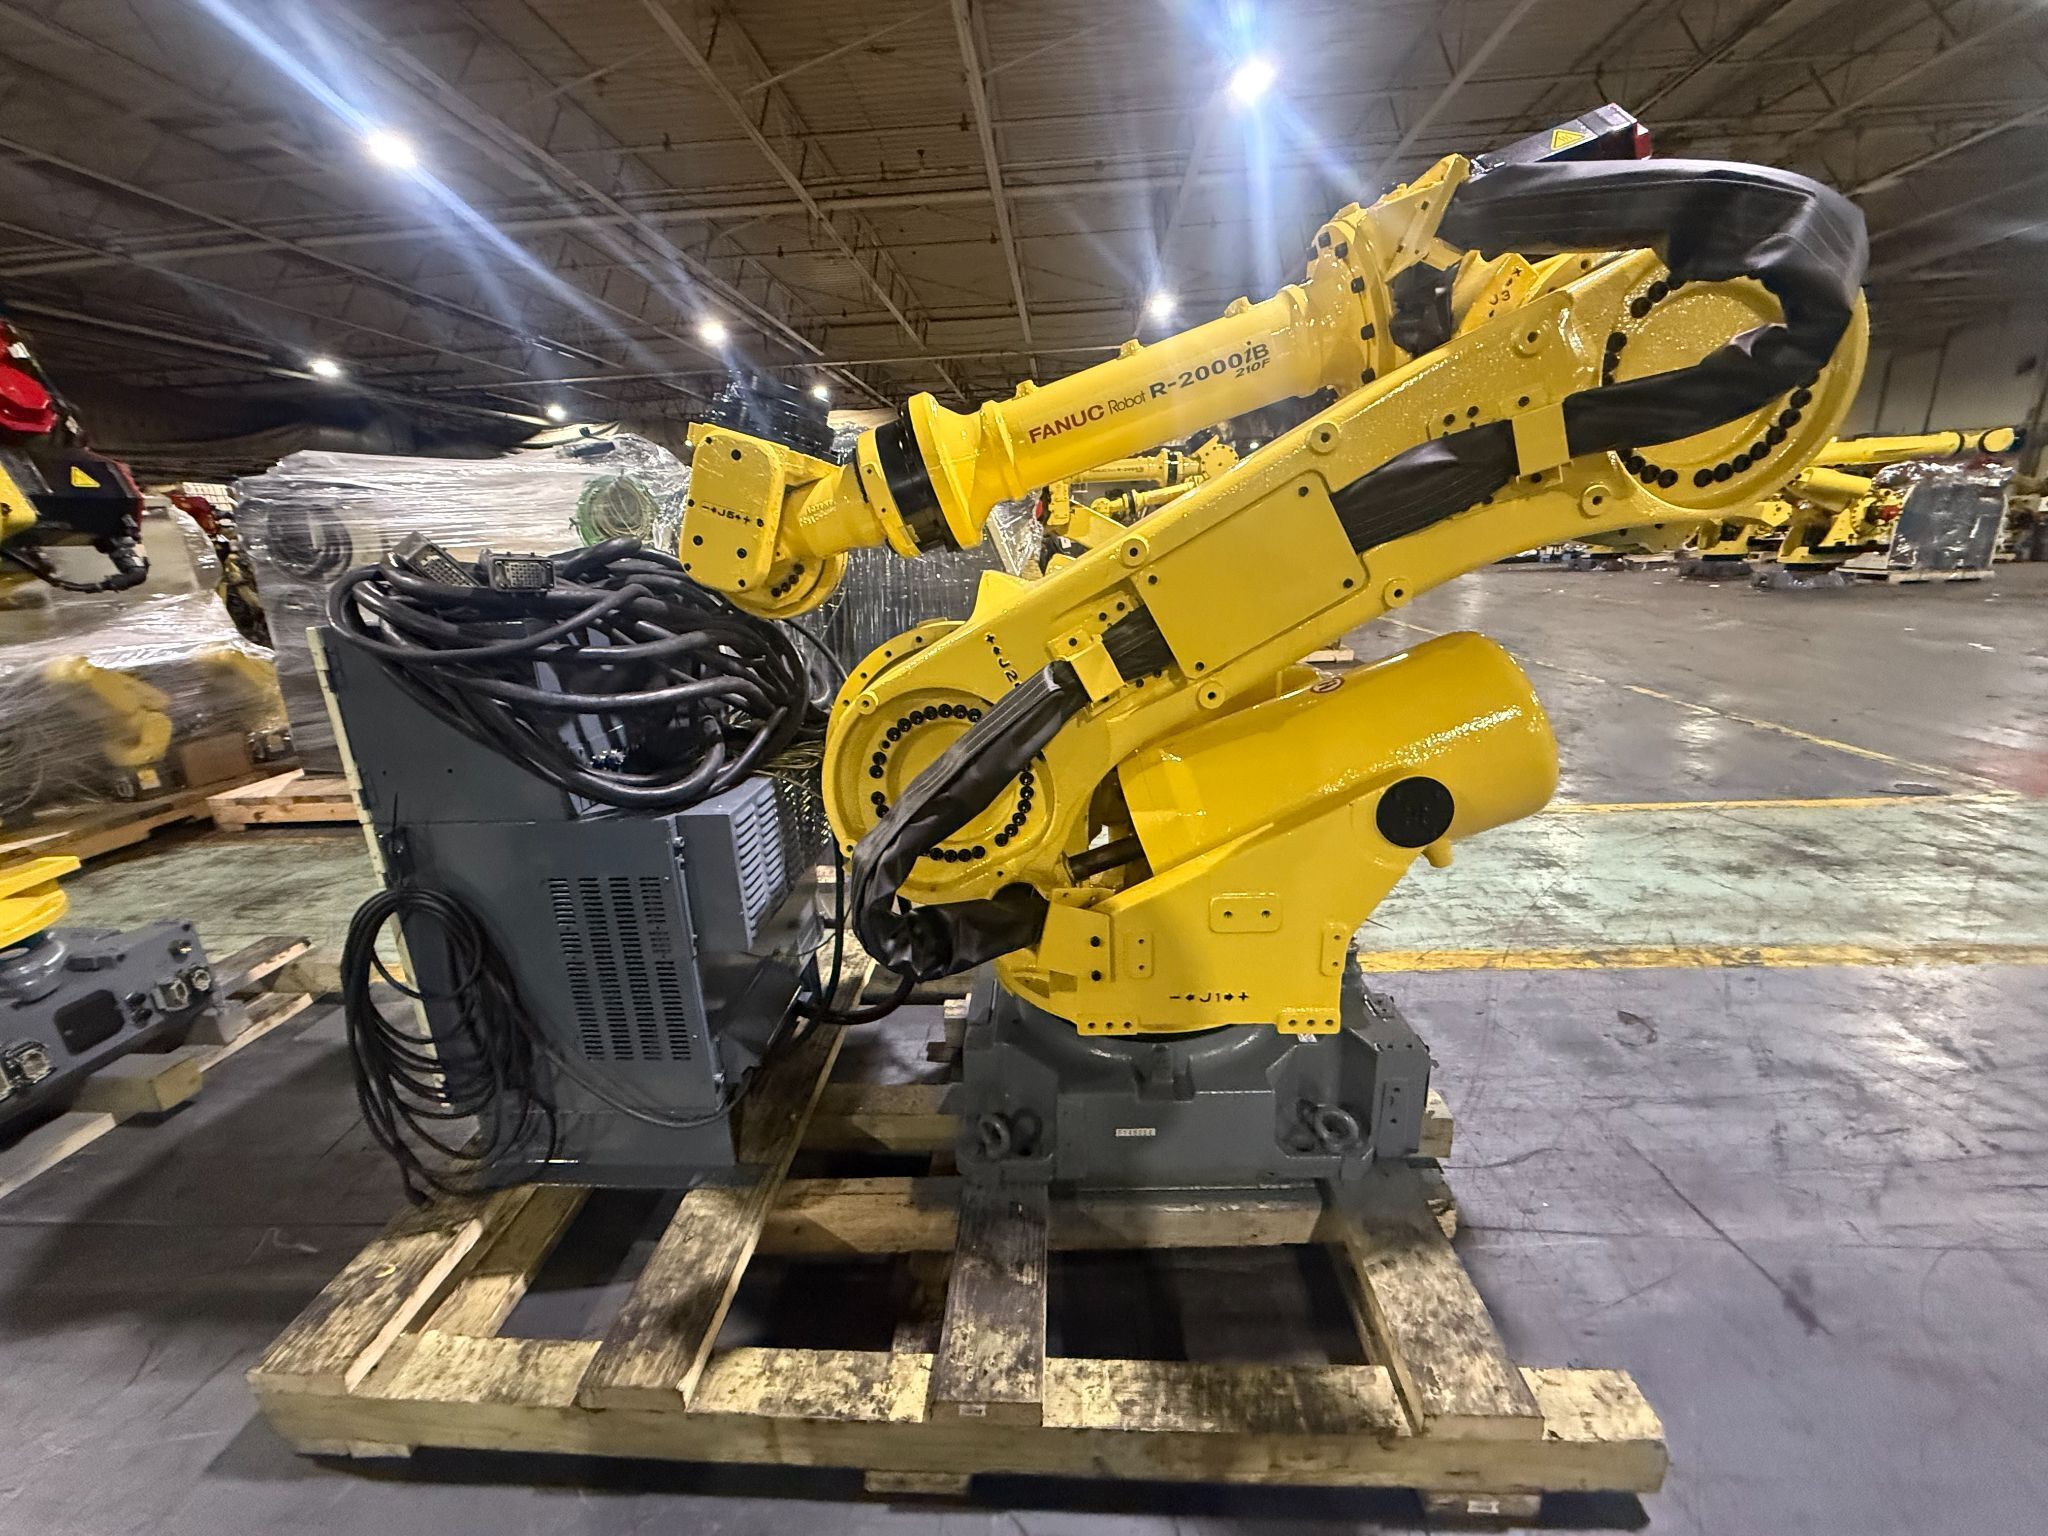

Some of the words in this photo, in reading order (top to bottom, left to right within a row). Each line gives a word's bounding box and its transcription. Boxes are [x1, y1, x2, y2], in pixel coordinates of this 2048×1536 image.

[1028, 404, 1105, 444] FANUC
[1108, 390, 1146, 415] Robot
[1149, 341, 1269, 399] R-2000iB
[1235, 358, 1270, 378] 210F
